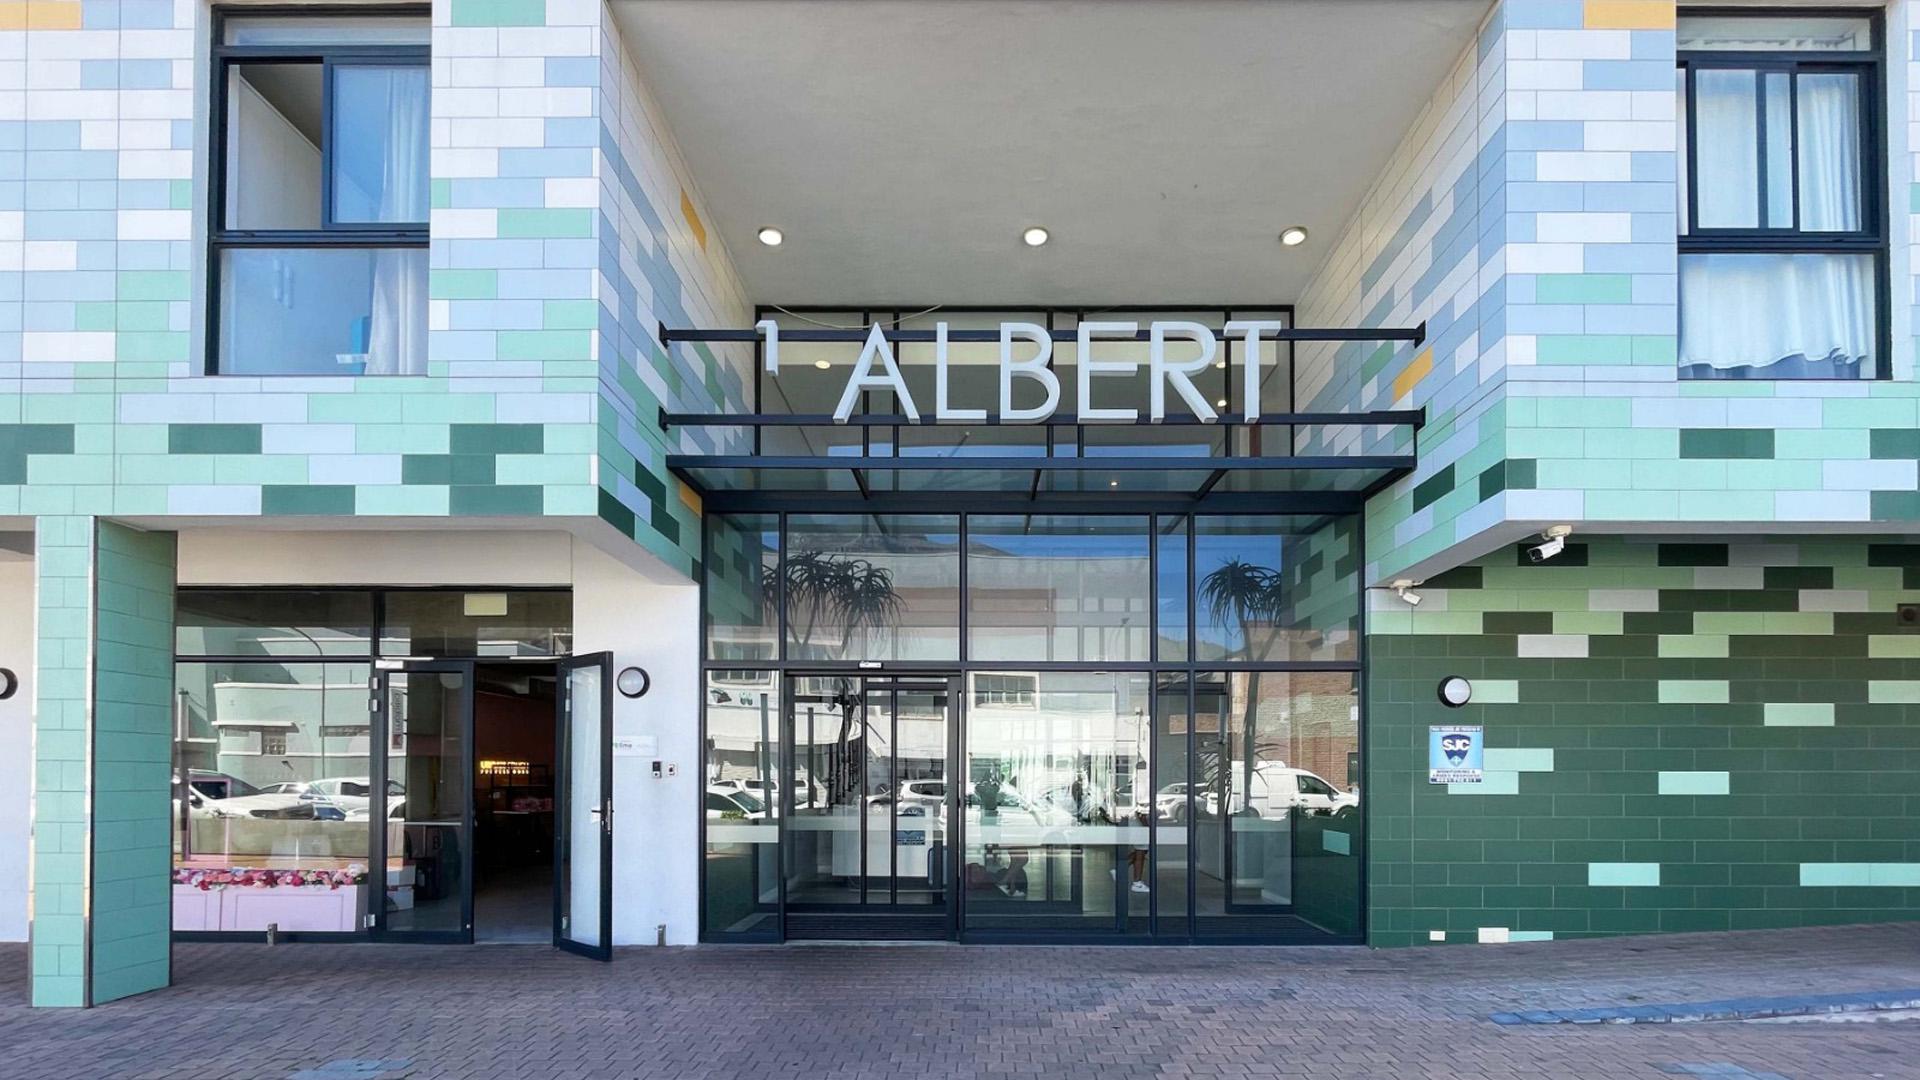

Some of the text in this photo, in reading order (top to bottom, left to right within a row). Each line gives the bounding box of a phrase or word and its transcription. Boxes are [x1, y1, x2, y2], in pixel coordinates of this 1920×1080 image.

[755, 319, 1281, 425] 1 ALBERT
[1443, 739, 1470, 751] SJC
